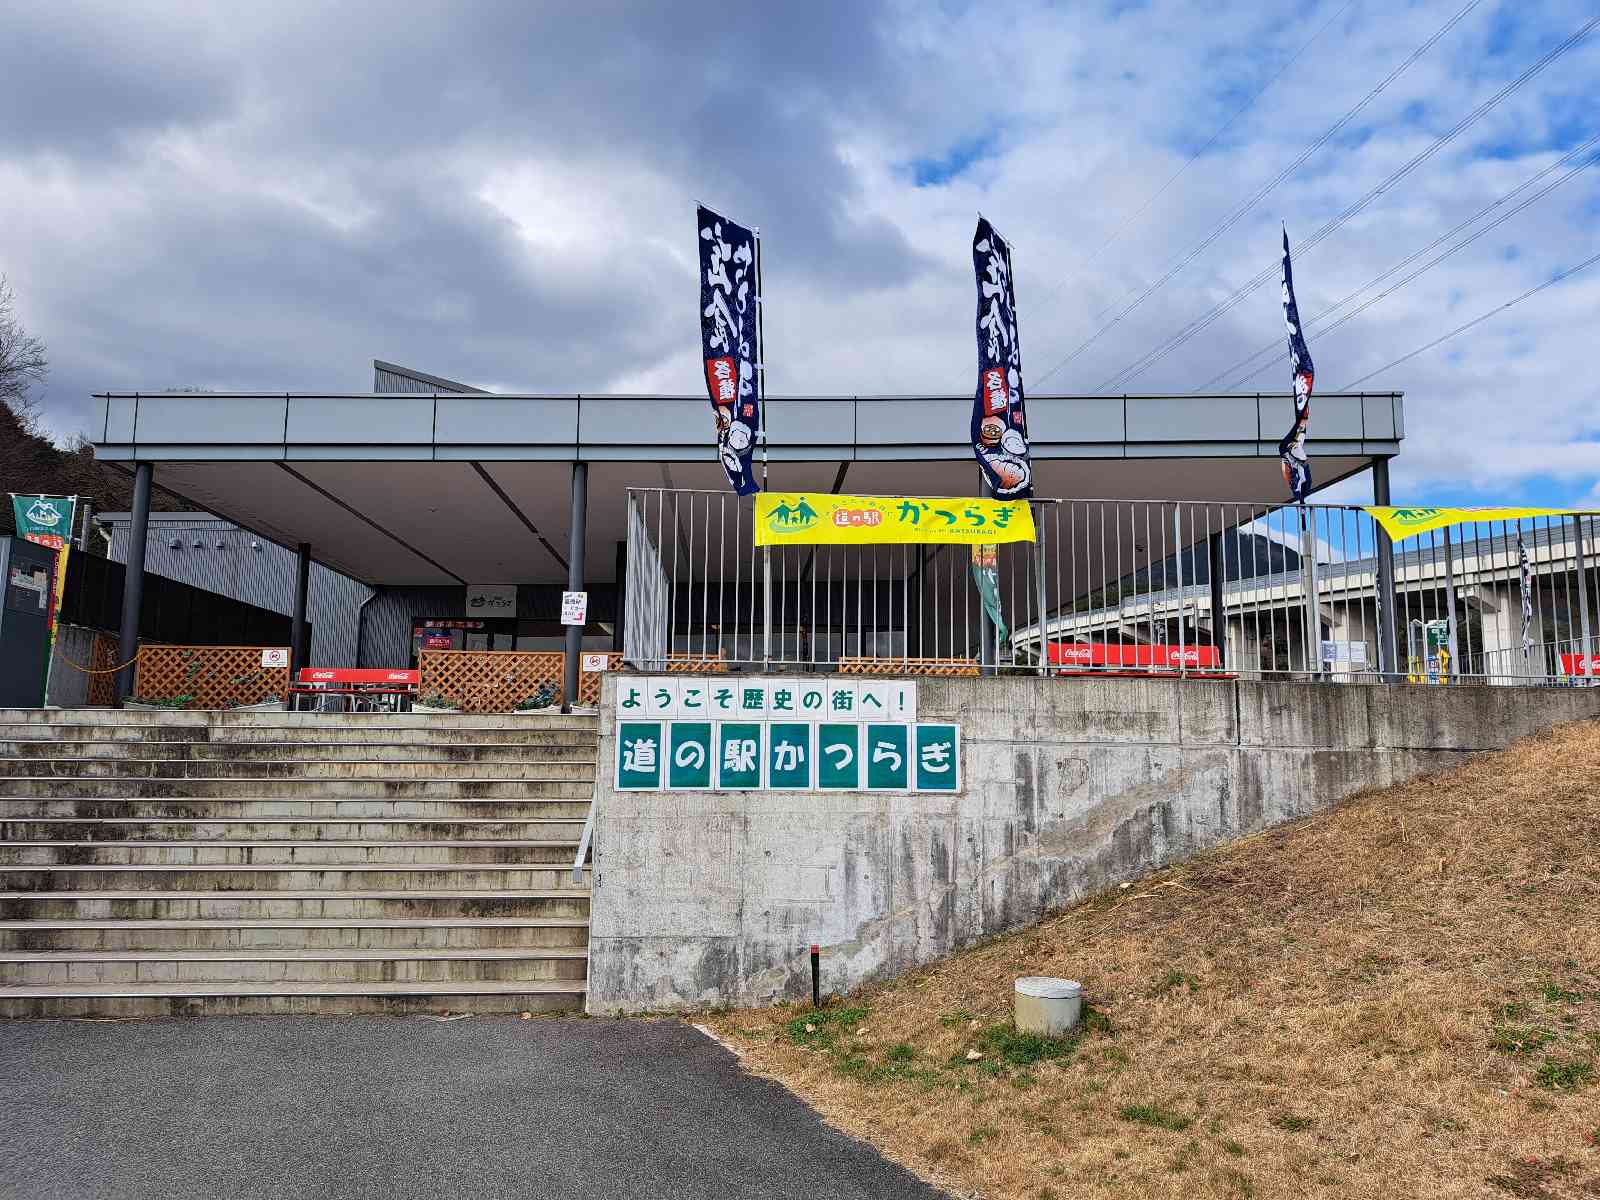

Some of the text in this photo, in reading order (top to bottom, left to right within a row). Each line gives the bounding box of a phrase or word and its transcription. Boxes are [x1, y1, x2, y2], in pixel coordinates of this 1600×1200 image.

[835, 511, 881, 526] 道の駅
[896, 500, 1021, 529] かつらぎ
[622, 687, 904, 713] ようこそ歴史の街へ！
[623, 738, 952, 774] 道の駅かつらぎ
